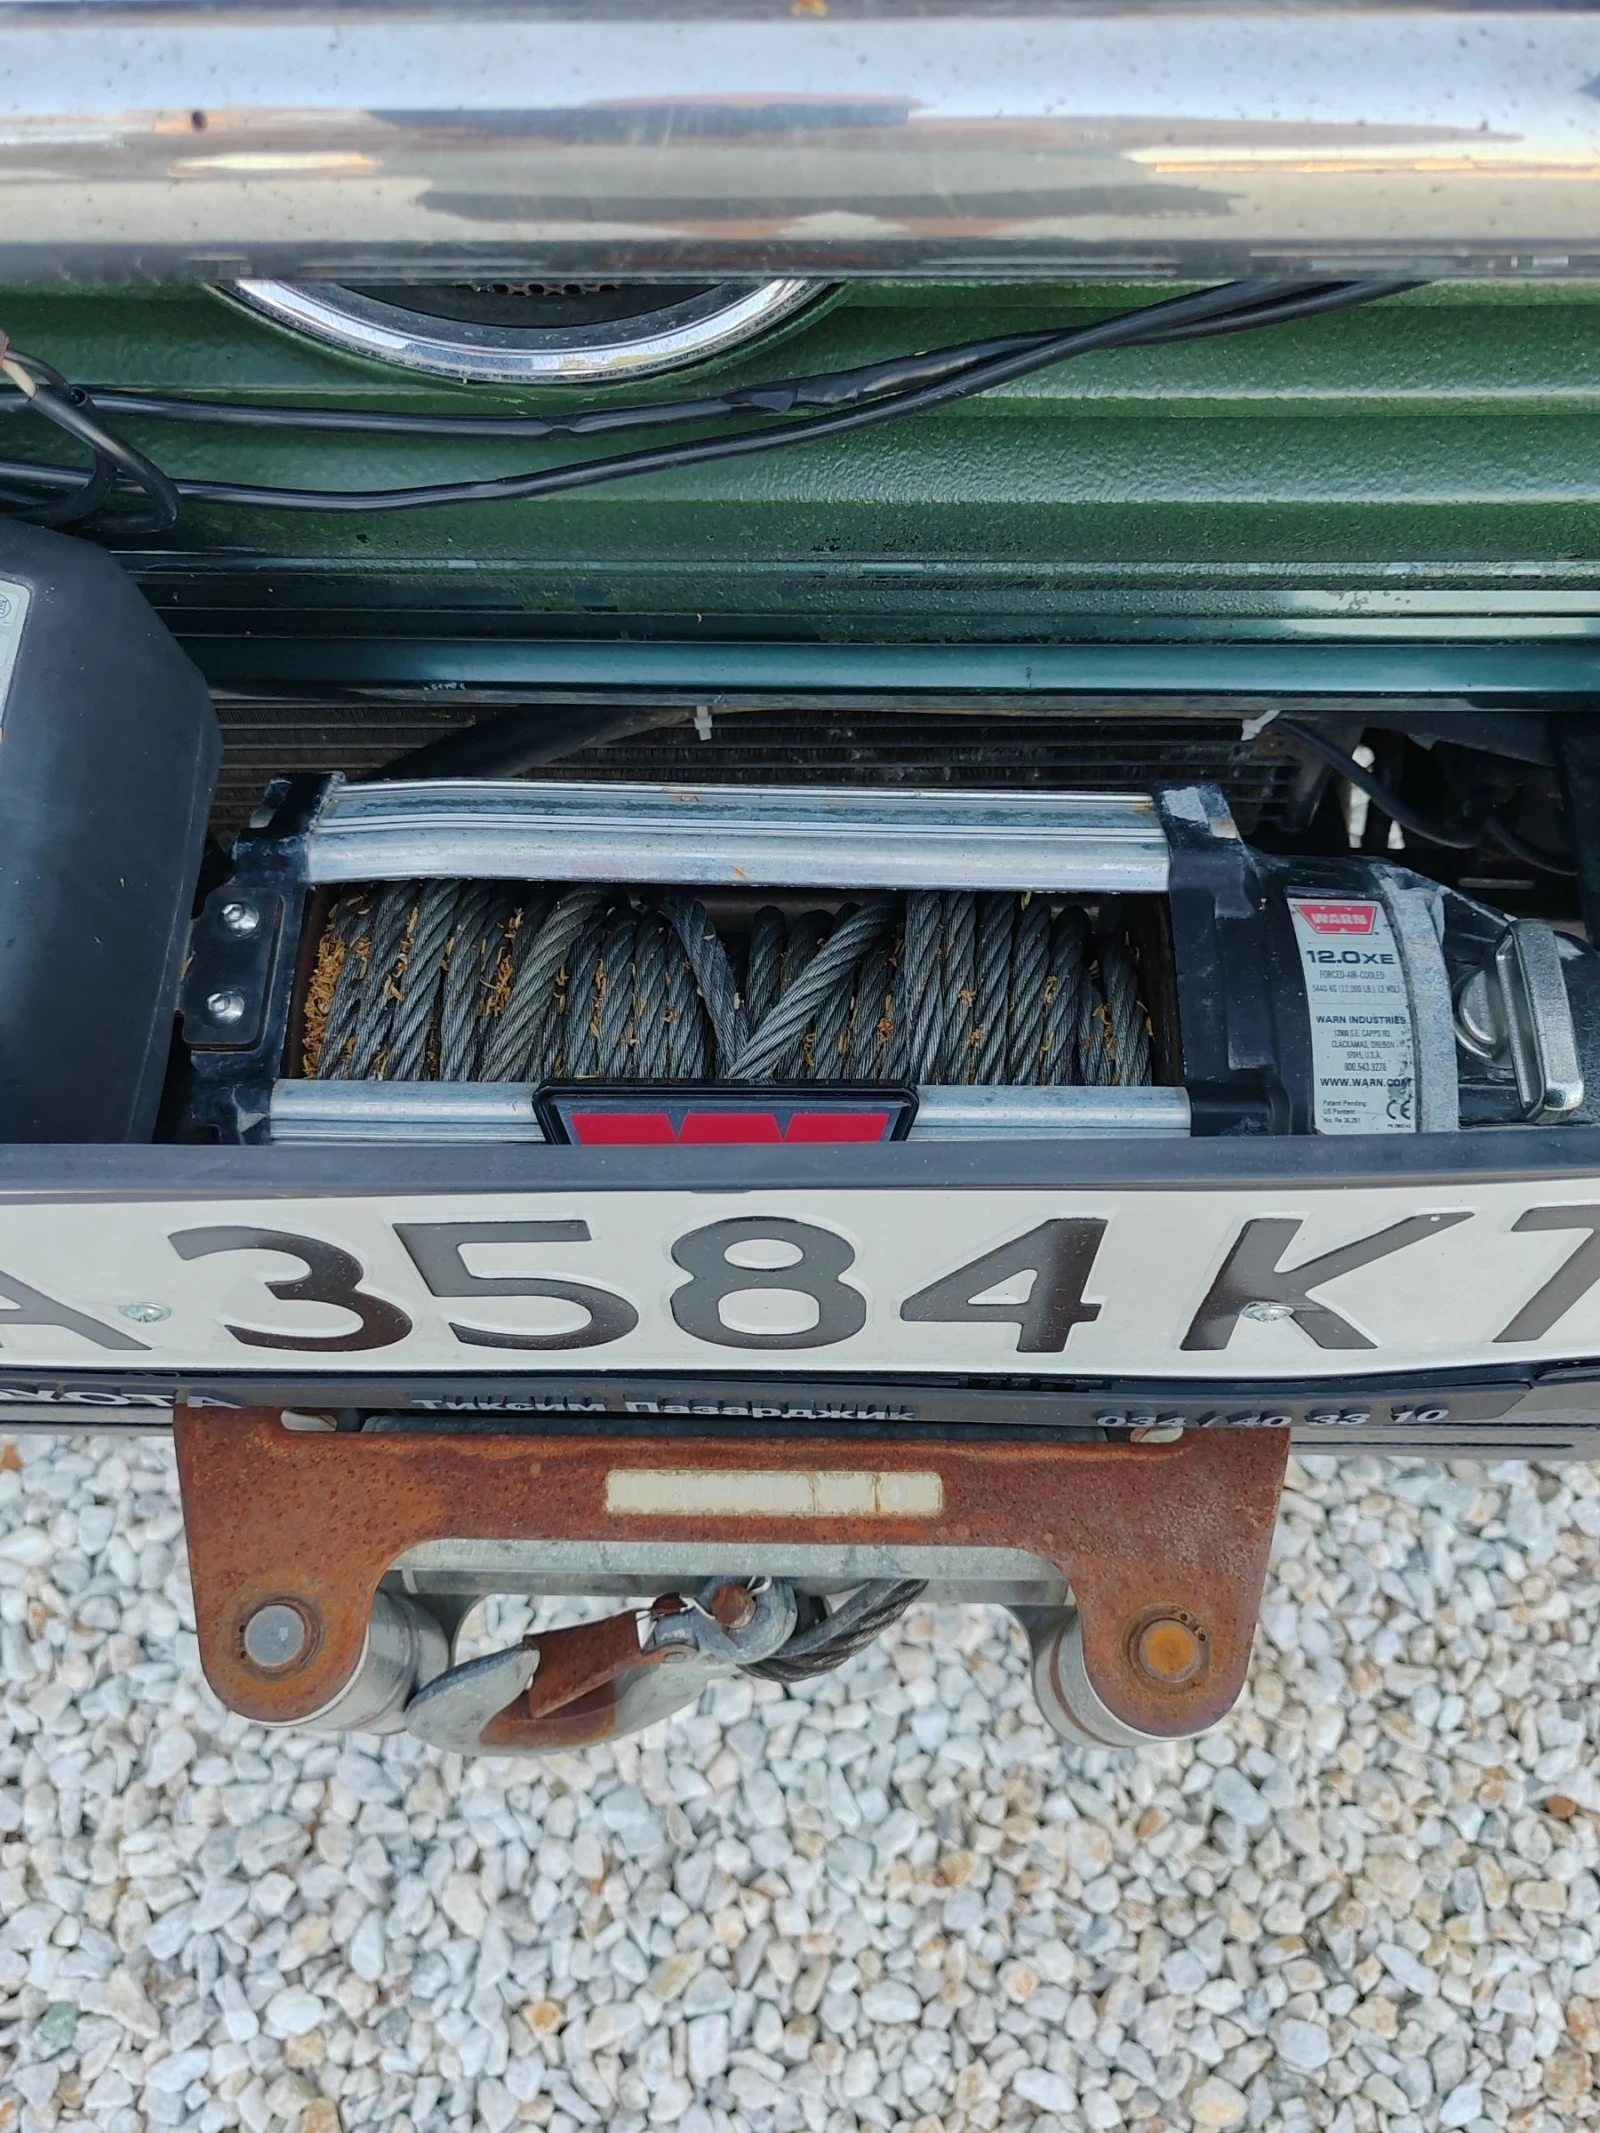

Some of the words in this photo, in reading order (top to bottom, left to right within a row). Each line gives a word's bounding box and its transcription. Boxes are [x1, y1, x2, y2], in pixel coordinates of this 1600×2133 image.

[1311, 913, 1368, 925] WARN
[1319, 970, 1385, 980] FORCED-AIR-COOLED
[1316, 1016, 1346, 1024] WARN
[1349, 1016, 1406, 1025] INDUSTRIES
[1371, 1041, 1395, 1049] OREGON
[1320, 1077, 1410, 1087] WWW.WARN.COM
[167, 1216, 1108, 1353] 3584
[411, 1399, 606, 1412] Тиксим
[623, 1400, 917, 1420] Пазарджик
[1096, 1415, 1187, 1428] 034
[1230, 1415, 1293, 1428] 40
[1393, 1409, 1450, 1423] 10
